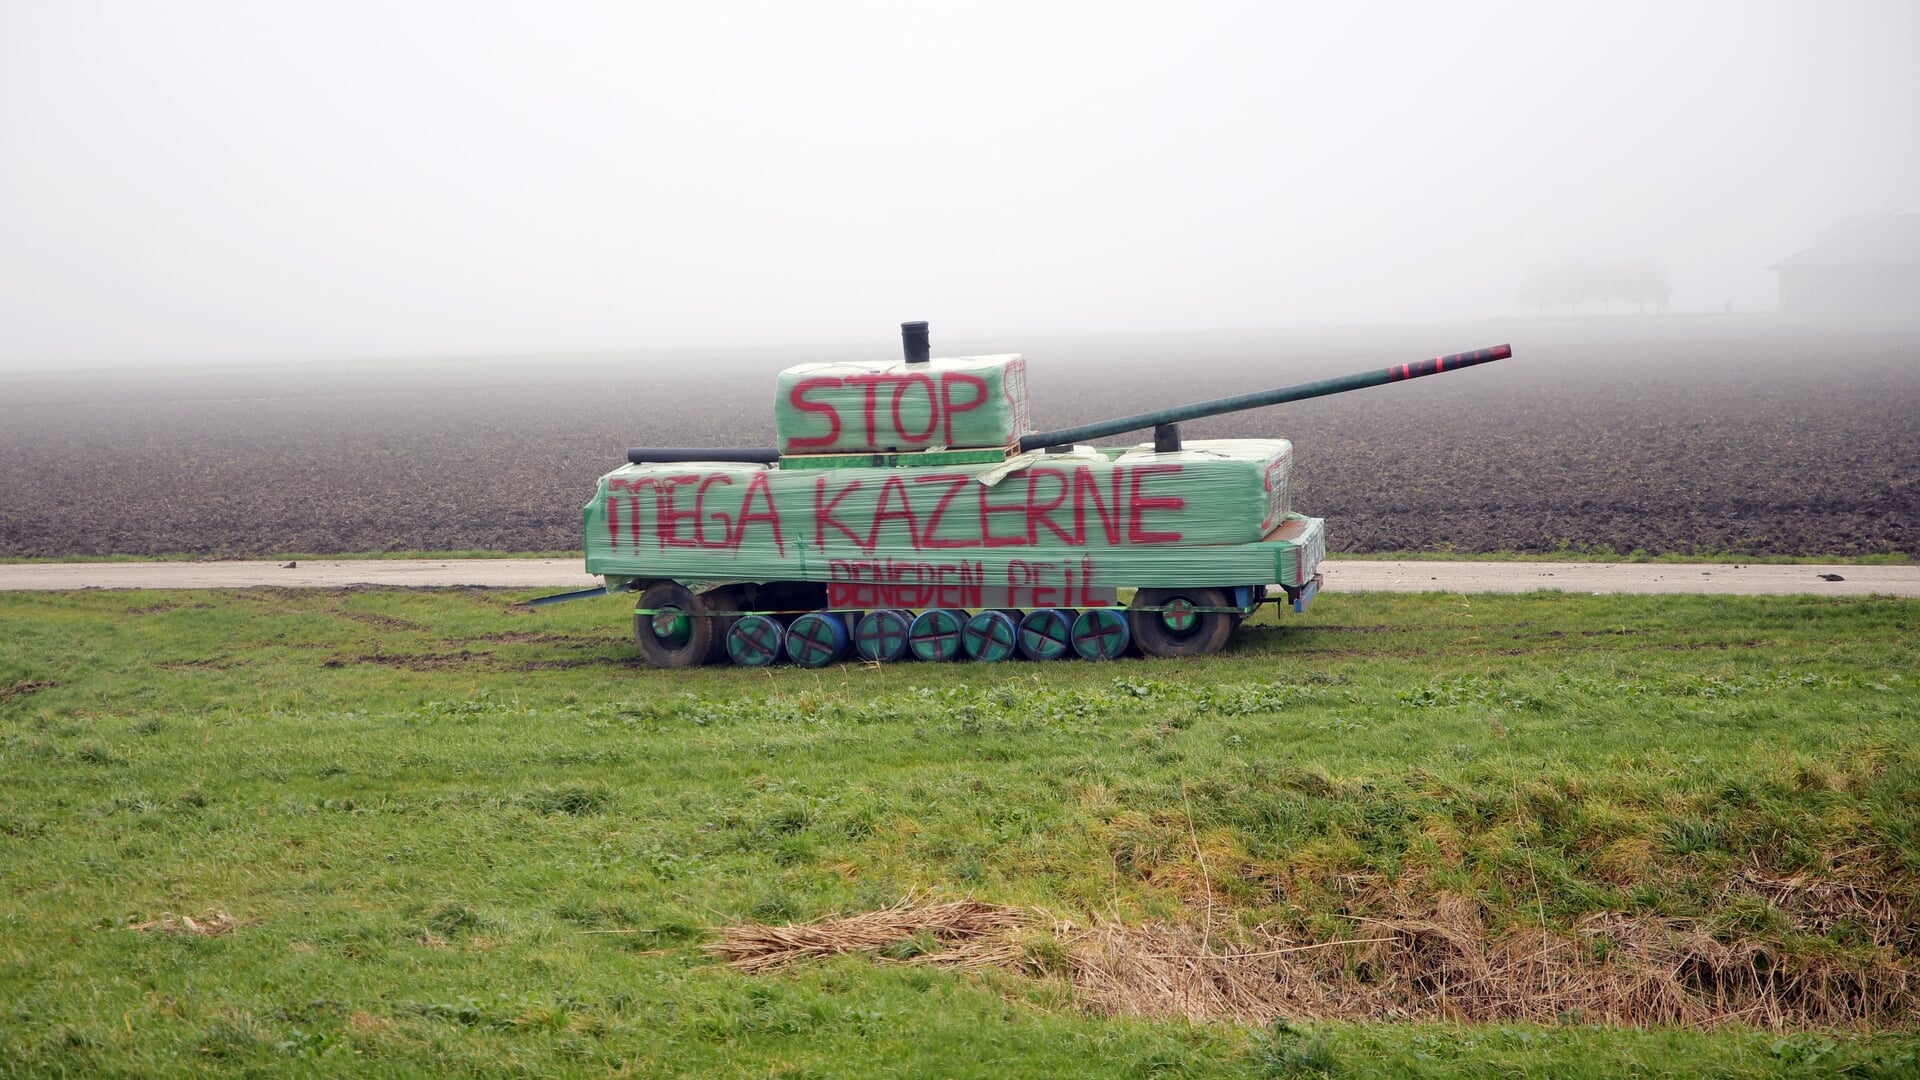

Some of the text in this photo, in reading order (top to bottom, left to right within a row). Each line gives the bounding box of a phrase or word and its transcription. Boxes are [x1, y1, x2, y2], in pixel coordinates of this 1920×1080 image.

[787, 373, 990, 449] STOP
[607, 472, 785, 559] MEGA
[814, 464, 1184, 555] KAZERNE
[828, 557, 983, 609] BENEDEN
